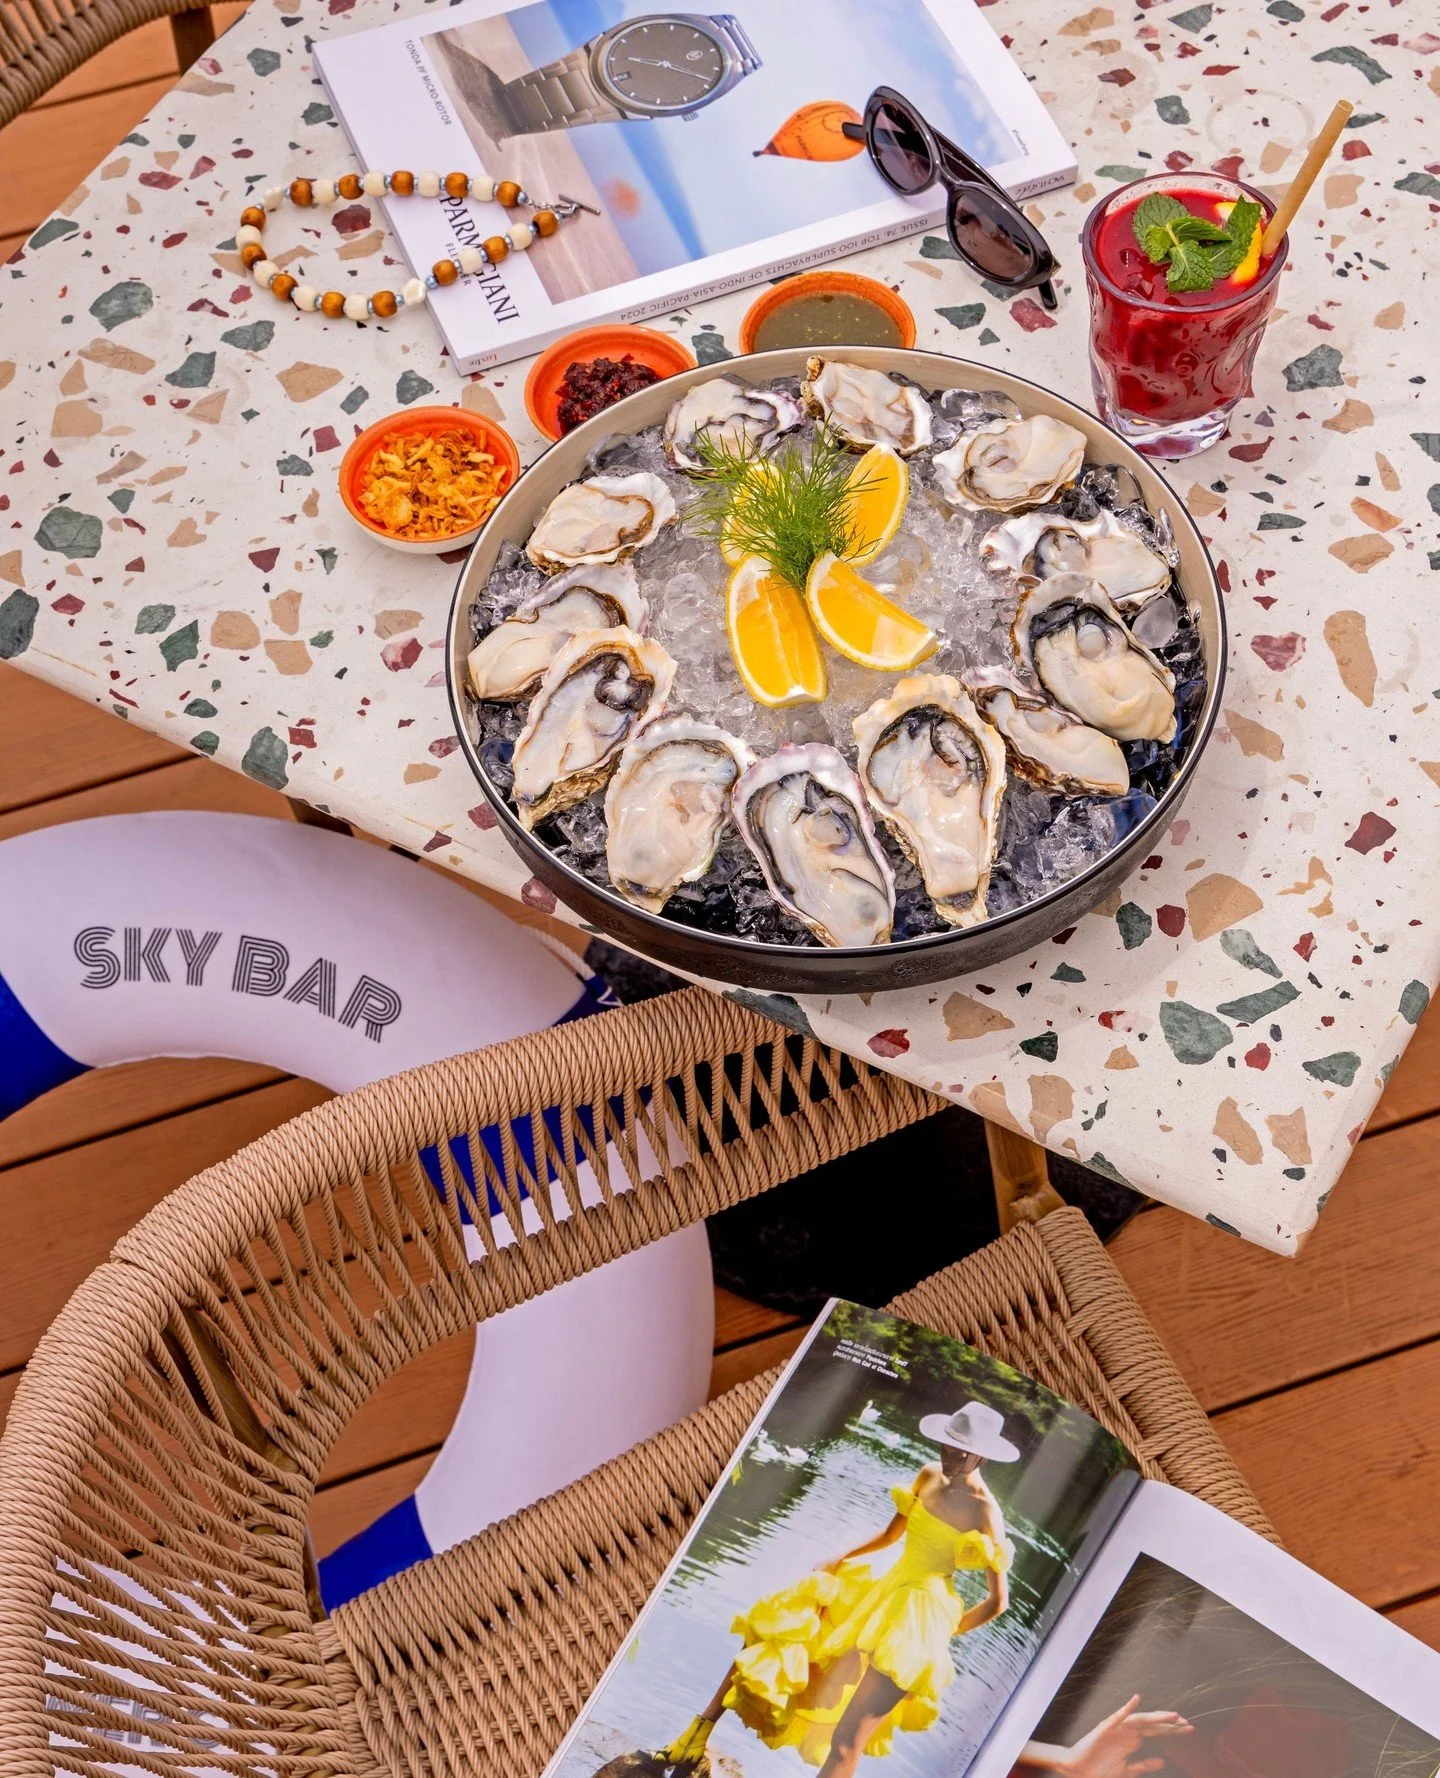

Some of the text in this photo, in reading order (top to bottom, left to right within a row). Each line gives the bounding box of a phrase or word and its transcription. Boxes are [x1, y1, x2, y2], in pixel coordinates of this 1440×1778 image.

[405, 39, 422, 66] TONDA
[422, 75, 452, 126] MICRO-ROTOR
[901, 219, 928, 232] ISSUE
[839, 241, 858, 252] 100
[861, 234, 881, 246] TOP
[439, 195, 520, 323] PARMGIANI
[445, 241, 472, 286] FLEER
[766, 247, 836, 275] SUPERYACHTS
[749, 271, 763, 282] OF
[650, 277, 746, 312] INDO-ASIA-PACIFIC
[620, 305, 646, 321] 2024
[73, 926, 402, 1043] SKY BAR
